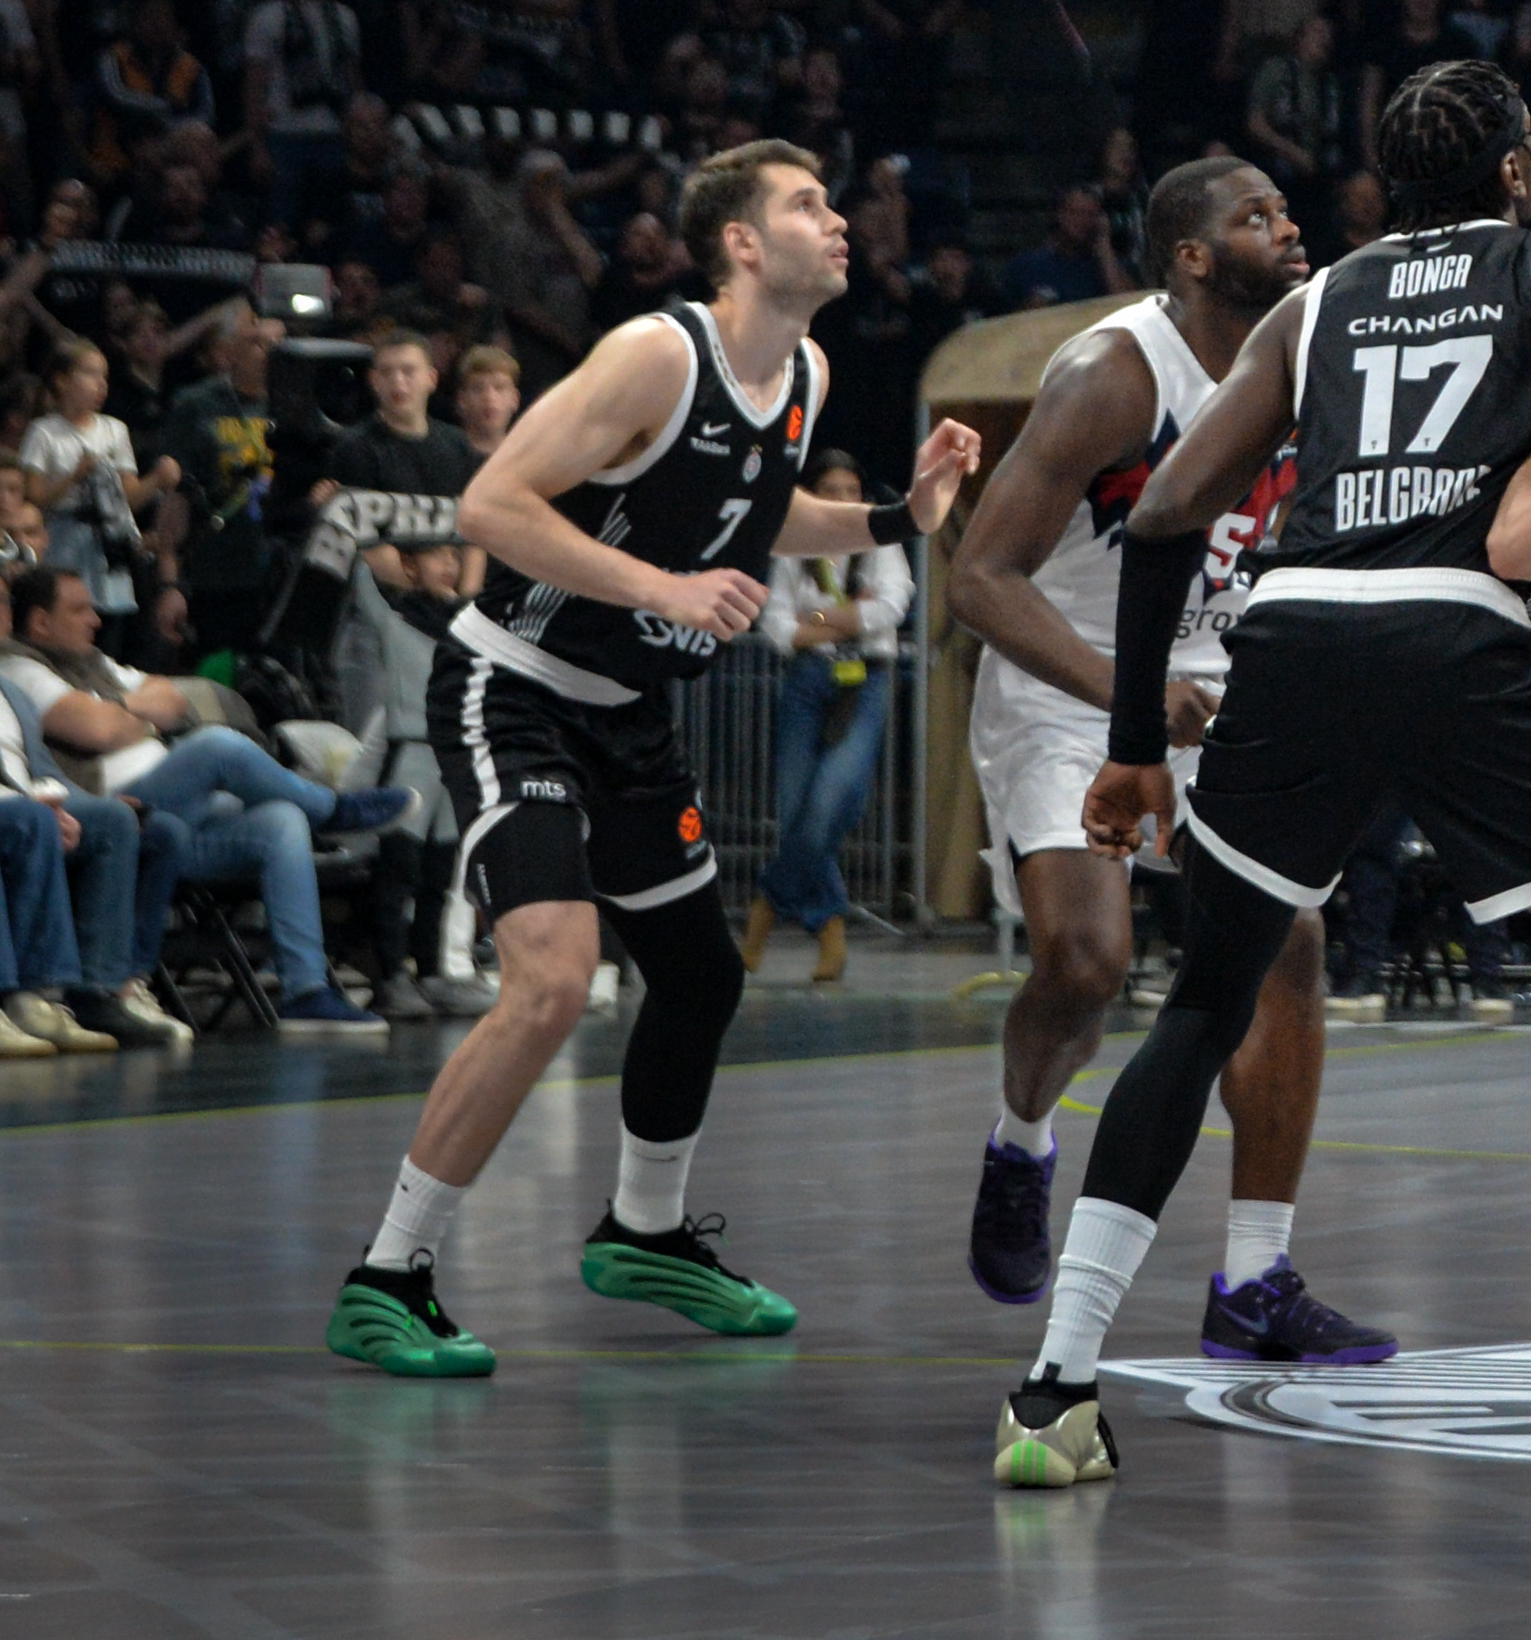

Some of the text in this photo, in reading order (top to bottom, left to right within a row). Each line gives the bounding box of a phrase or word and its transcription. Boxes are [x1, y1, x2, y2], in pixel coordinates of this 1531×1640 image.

[1388, 253, 1474, 299] BONGA
[1347, 303, 1504, 336] CHANGAN
[1353, 334, 1494, 458] 17
[700, 497, 753, 561] 7
[520, 779, 567, 802] mts
